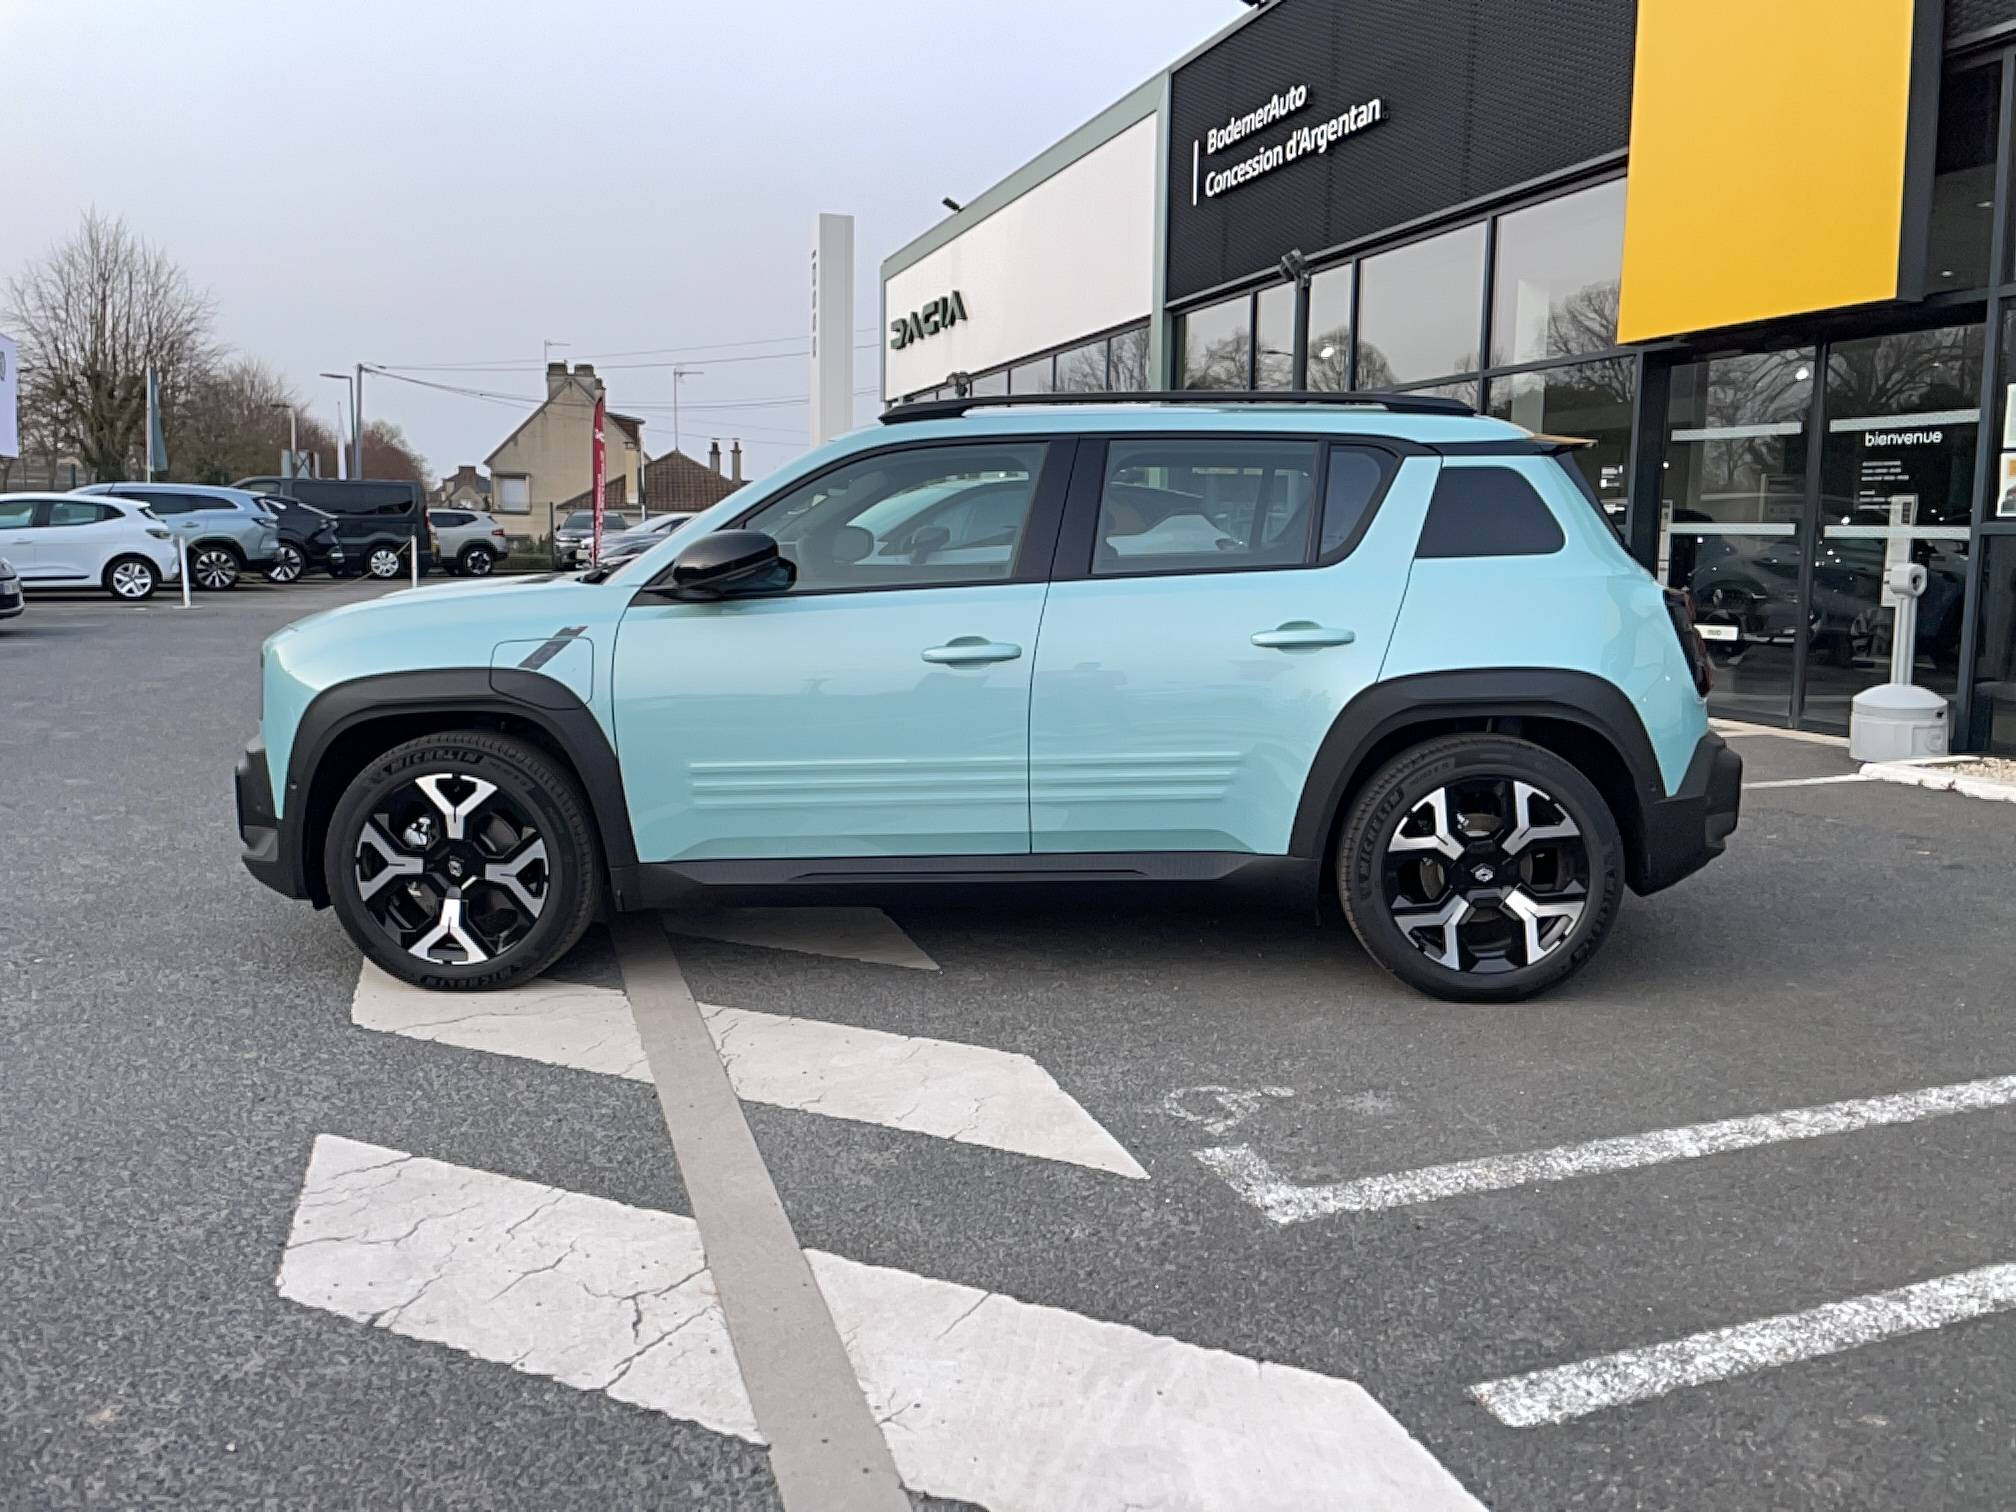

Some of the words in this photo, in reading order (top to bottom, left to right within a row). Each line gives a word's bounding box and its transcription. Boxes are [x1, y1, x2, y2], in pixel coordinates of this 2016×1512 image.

[1205, 147, 1283, 197] Concession
[1286, 98, 1381, 161] d'Argentan
[1206, 84, 1307, 154] BodemerAuto
[890, 290, 968, 349] DACIA
[1864, 431, 1943, 447] bienvenue
